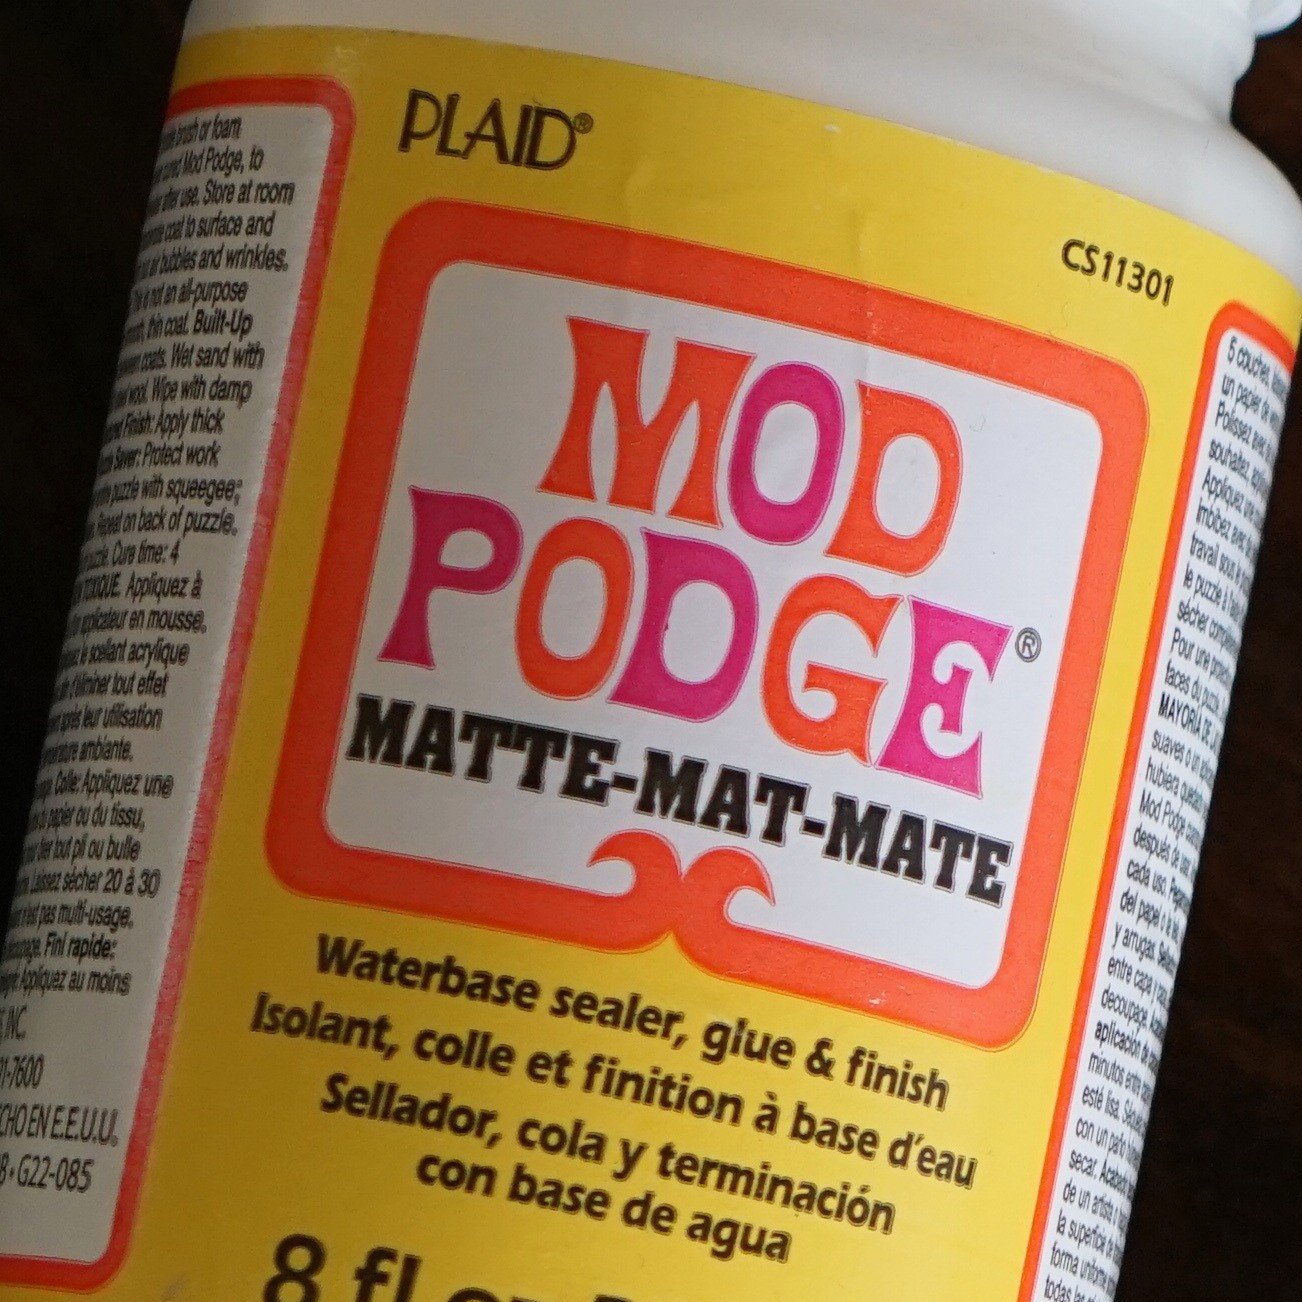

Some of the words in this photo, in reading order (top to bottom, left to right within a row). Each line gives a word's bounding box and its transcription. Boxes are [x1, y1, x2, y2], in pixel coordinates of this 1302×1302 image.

[238, 181, 253, 204] at
[255, 180, 295, 206] room
[1060, 238, 1175, 308] CS11301
[208, 375, 253, 409] damp
[233, 341, 265, 370] with
[538, 316, 962, 577] MOD
[346, 694, 1013, 907] MATTE-MAT-MATE
[250, 992, 398, 1059] Isolant,
[412, 1022, 516, 1081] colle
[526, 1050, 570, 1088] et
[582, 1055, 743, 1126] finition
[753, 1089, 778, 1134] à
[790, 1101, 897, 1168] base
[887, 1131, 978, 1191] d'eau
[317, 933, 540, 1013] Waterbase
[549, 986, 688, 1051] sealer,
[702, 1019, 795, 1069] glue
[806, 1039, 836, 1080] &
[847, 1045, 949, 1112] finish
[321, 1072, 503, 1149] Sellador,
[517, 1111, 603, 1164] cola
[615, 1141, 646, 1181] y
[656, 1141, 895, 1236] terminación
[416, 1150, 495, 1197] con
[507, 1162, 611, 1222] base
[620, 1189, 675, 1236] de
[686, 1209, 792, 1266] agua
